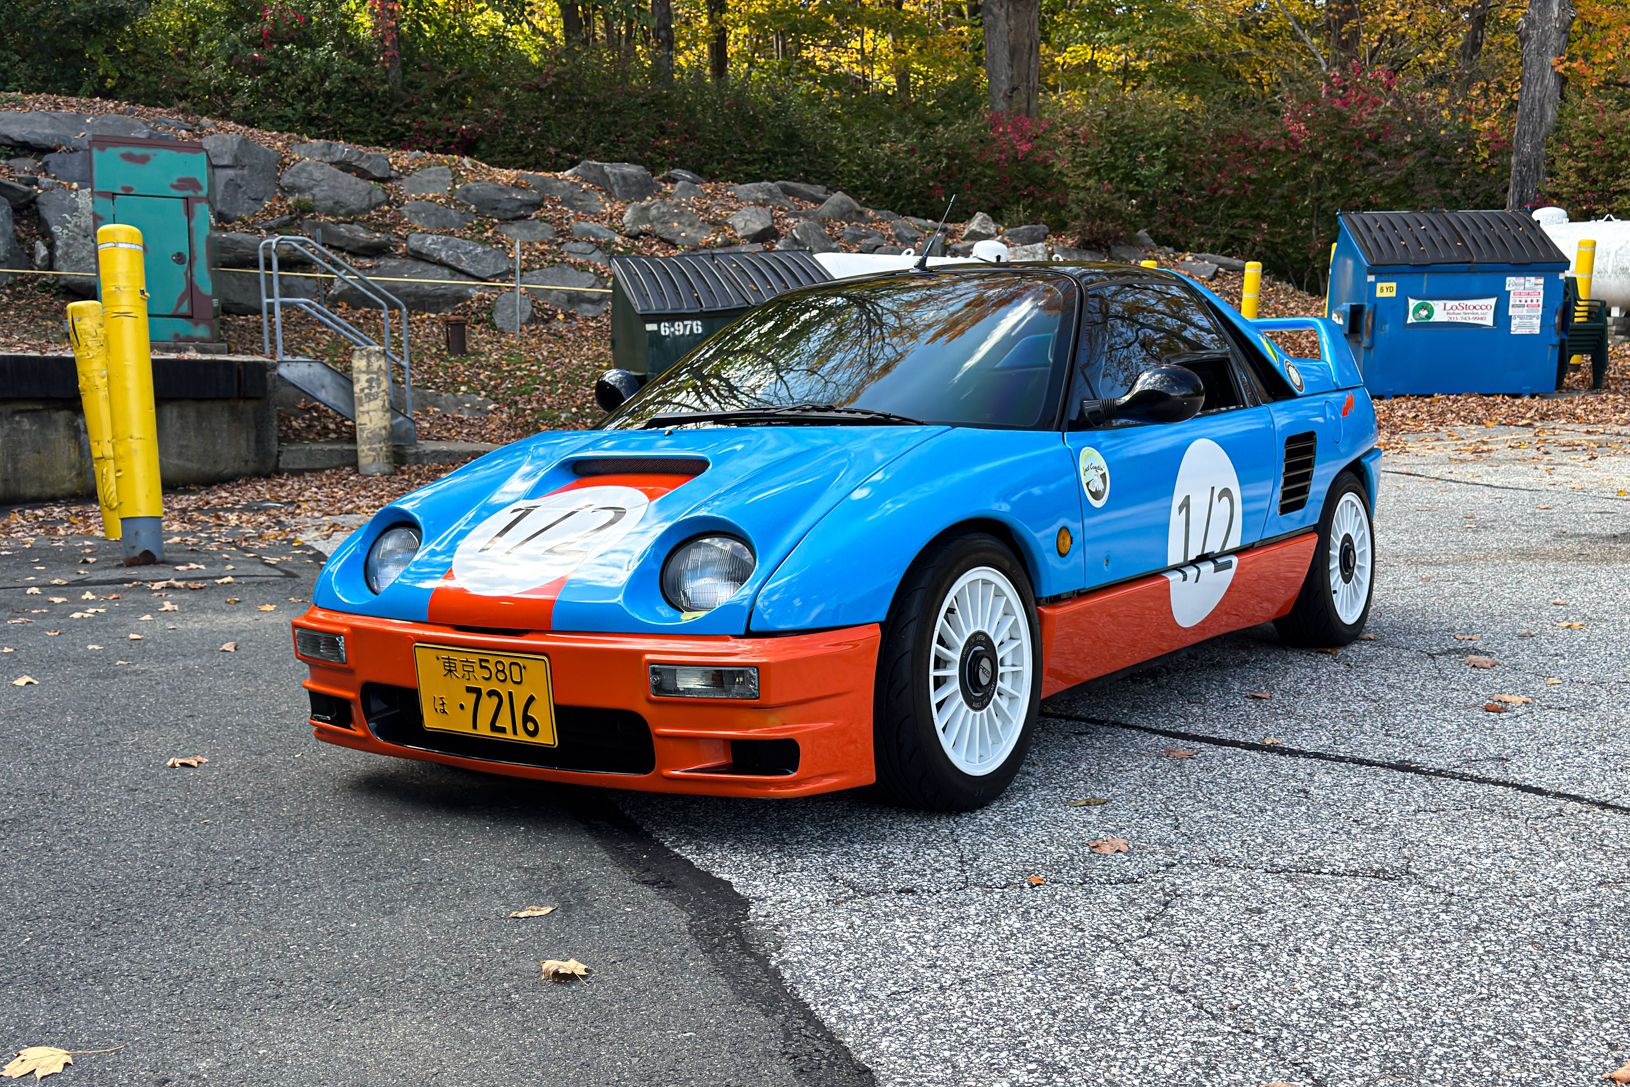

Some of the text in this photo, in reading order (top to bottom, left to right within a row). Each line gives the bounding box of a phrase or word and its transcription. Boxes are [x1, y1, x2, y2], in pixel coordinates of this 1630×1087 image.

[1442, 302, 1493, 311] LoStocco
[478, 504, 627, 556] 1/2
[1178, 486, 1235, 583] 1/2
